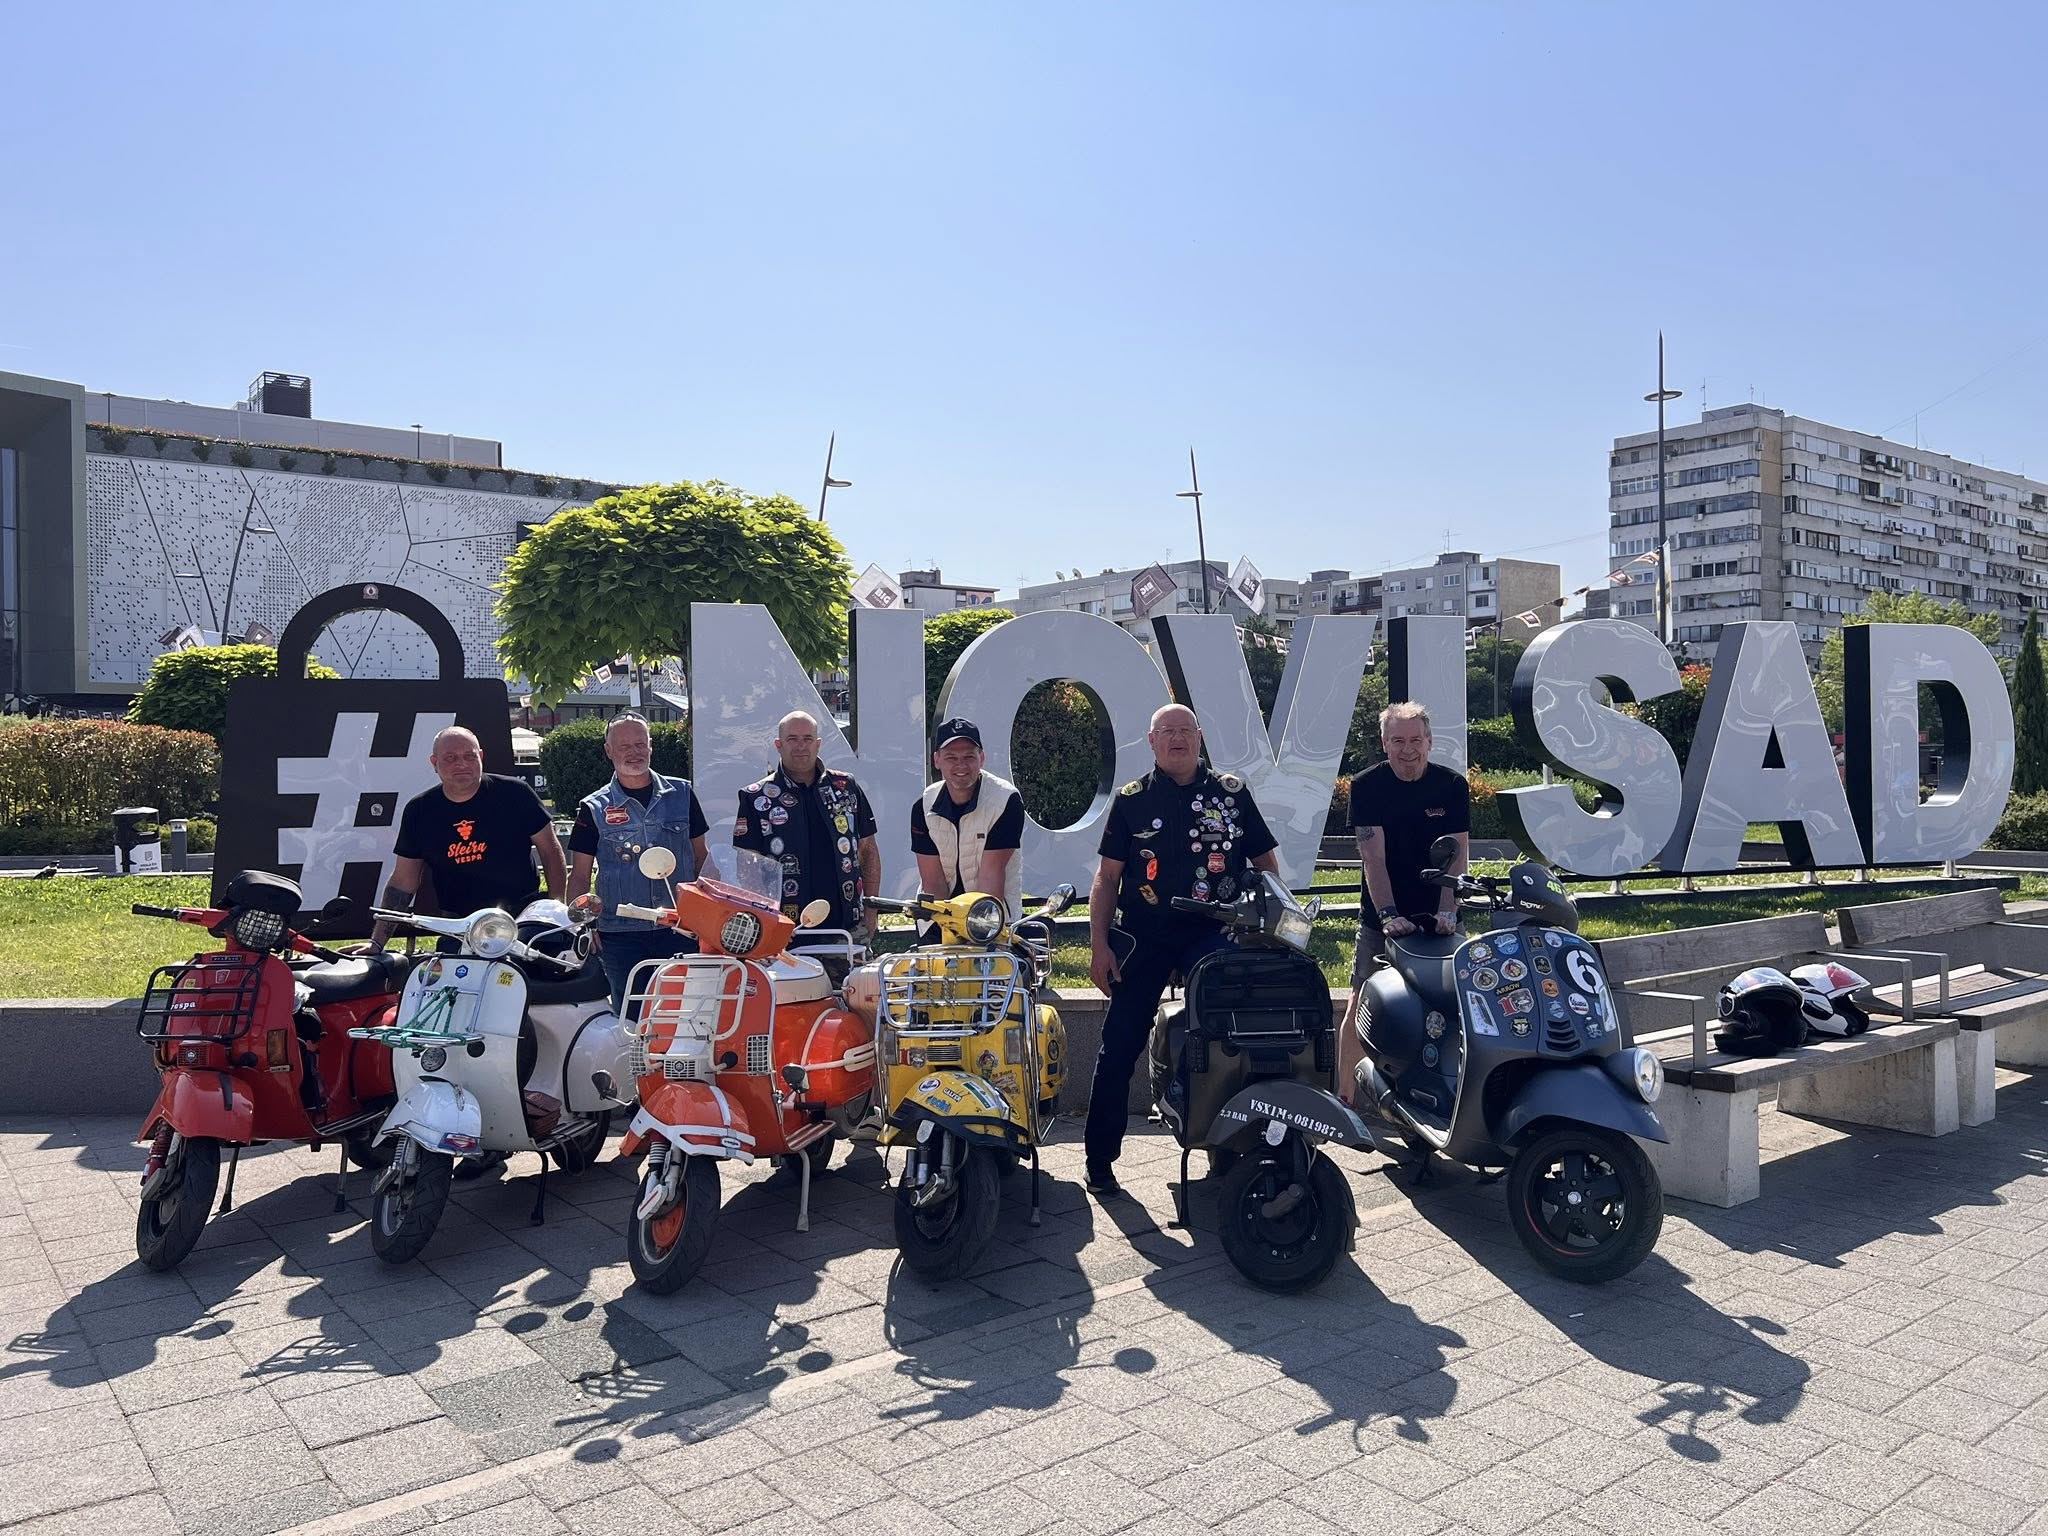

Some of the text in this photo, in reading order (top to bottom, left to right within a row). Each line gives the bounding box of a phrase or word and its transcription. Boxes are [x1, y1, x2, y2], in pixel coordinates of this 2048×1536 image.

[874, 587, 892, 605] BIG
[690, 602, 1468, 896] NOVI
[1497, 618, 2016, 877] SAD
[455, 853, 483, 865] VESPA
[1566, 949, 1604, 995] 6
[1294, 1114, 1337, 1137] 081987
